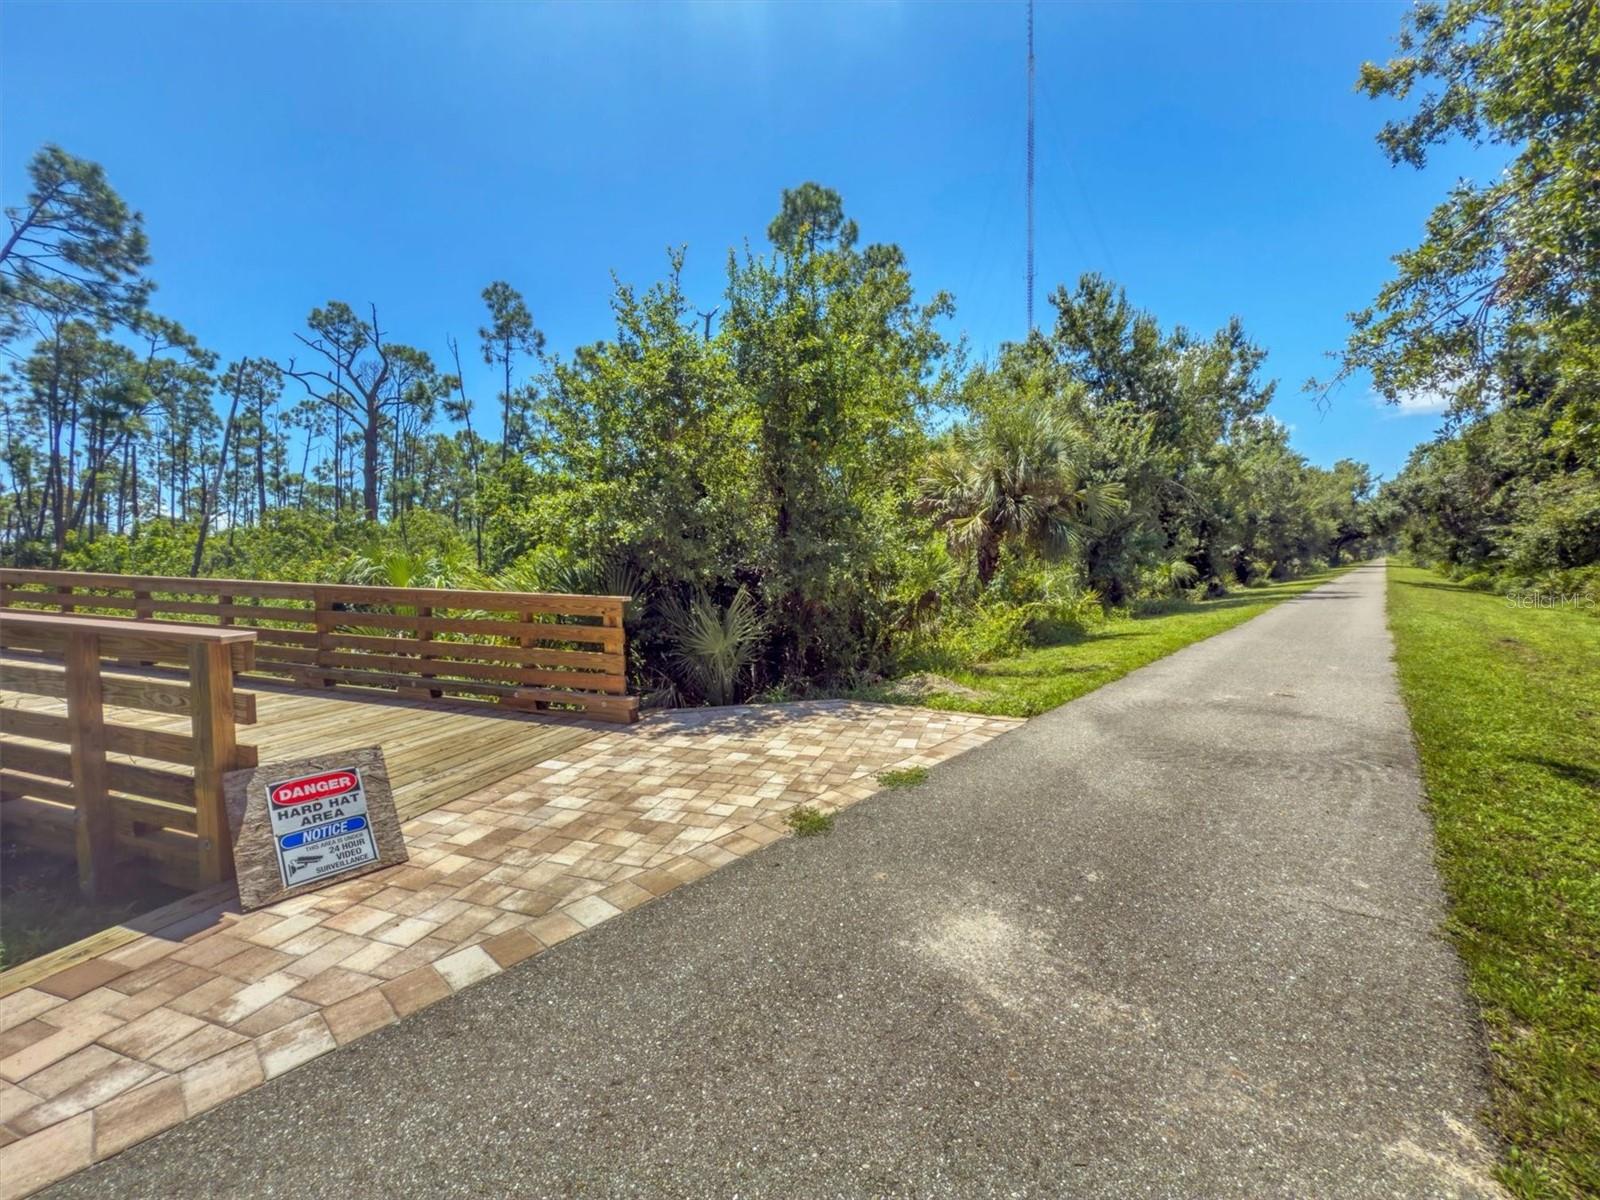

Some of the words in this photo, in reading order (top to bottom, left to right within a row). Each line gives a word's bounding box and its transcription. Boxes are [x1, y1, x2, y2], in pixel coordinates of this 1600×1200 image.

[279, 776, 352, 801] DANGER
[277, 802, 323, 820] HARD
[329, 793, 360, 808] HAT
[301, 808, 344, 826] AREA
[302, 821, 348, 843] NOTICE
[320, 840, 336, 848] AREA
[344, 832, 364, 841] UNDER
[329, 845, 340, 854] 24
[341, 838, 366, 850] HOUR
[336, 847, 362, 860] VIDEO
[316, 853, 369, 874] SURVEILLANCE
